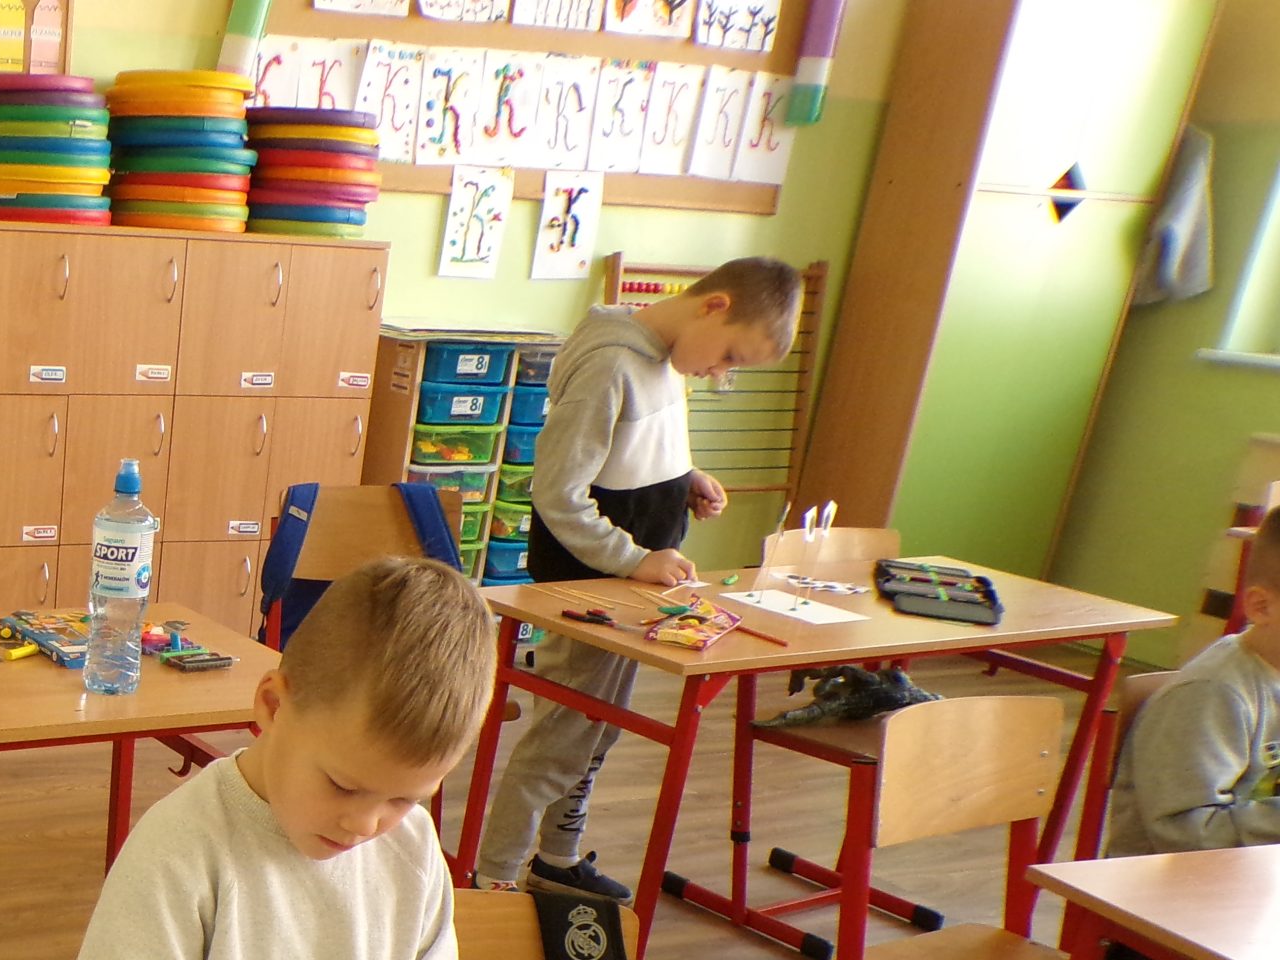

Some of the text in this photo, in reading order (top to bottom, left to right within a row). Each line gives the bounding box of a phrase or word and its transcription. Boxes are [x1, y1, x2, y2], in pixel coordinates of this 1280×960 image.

[376, 62, 409, 132] K
[428, 68, 469, 154] K
[484, 64, 526, 138] K
[652, 80, 688, 146] K
[750, 92, 784, 151] K
[95, 545, 136, 560] SPORT
